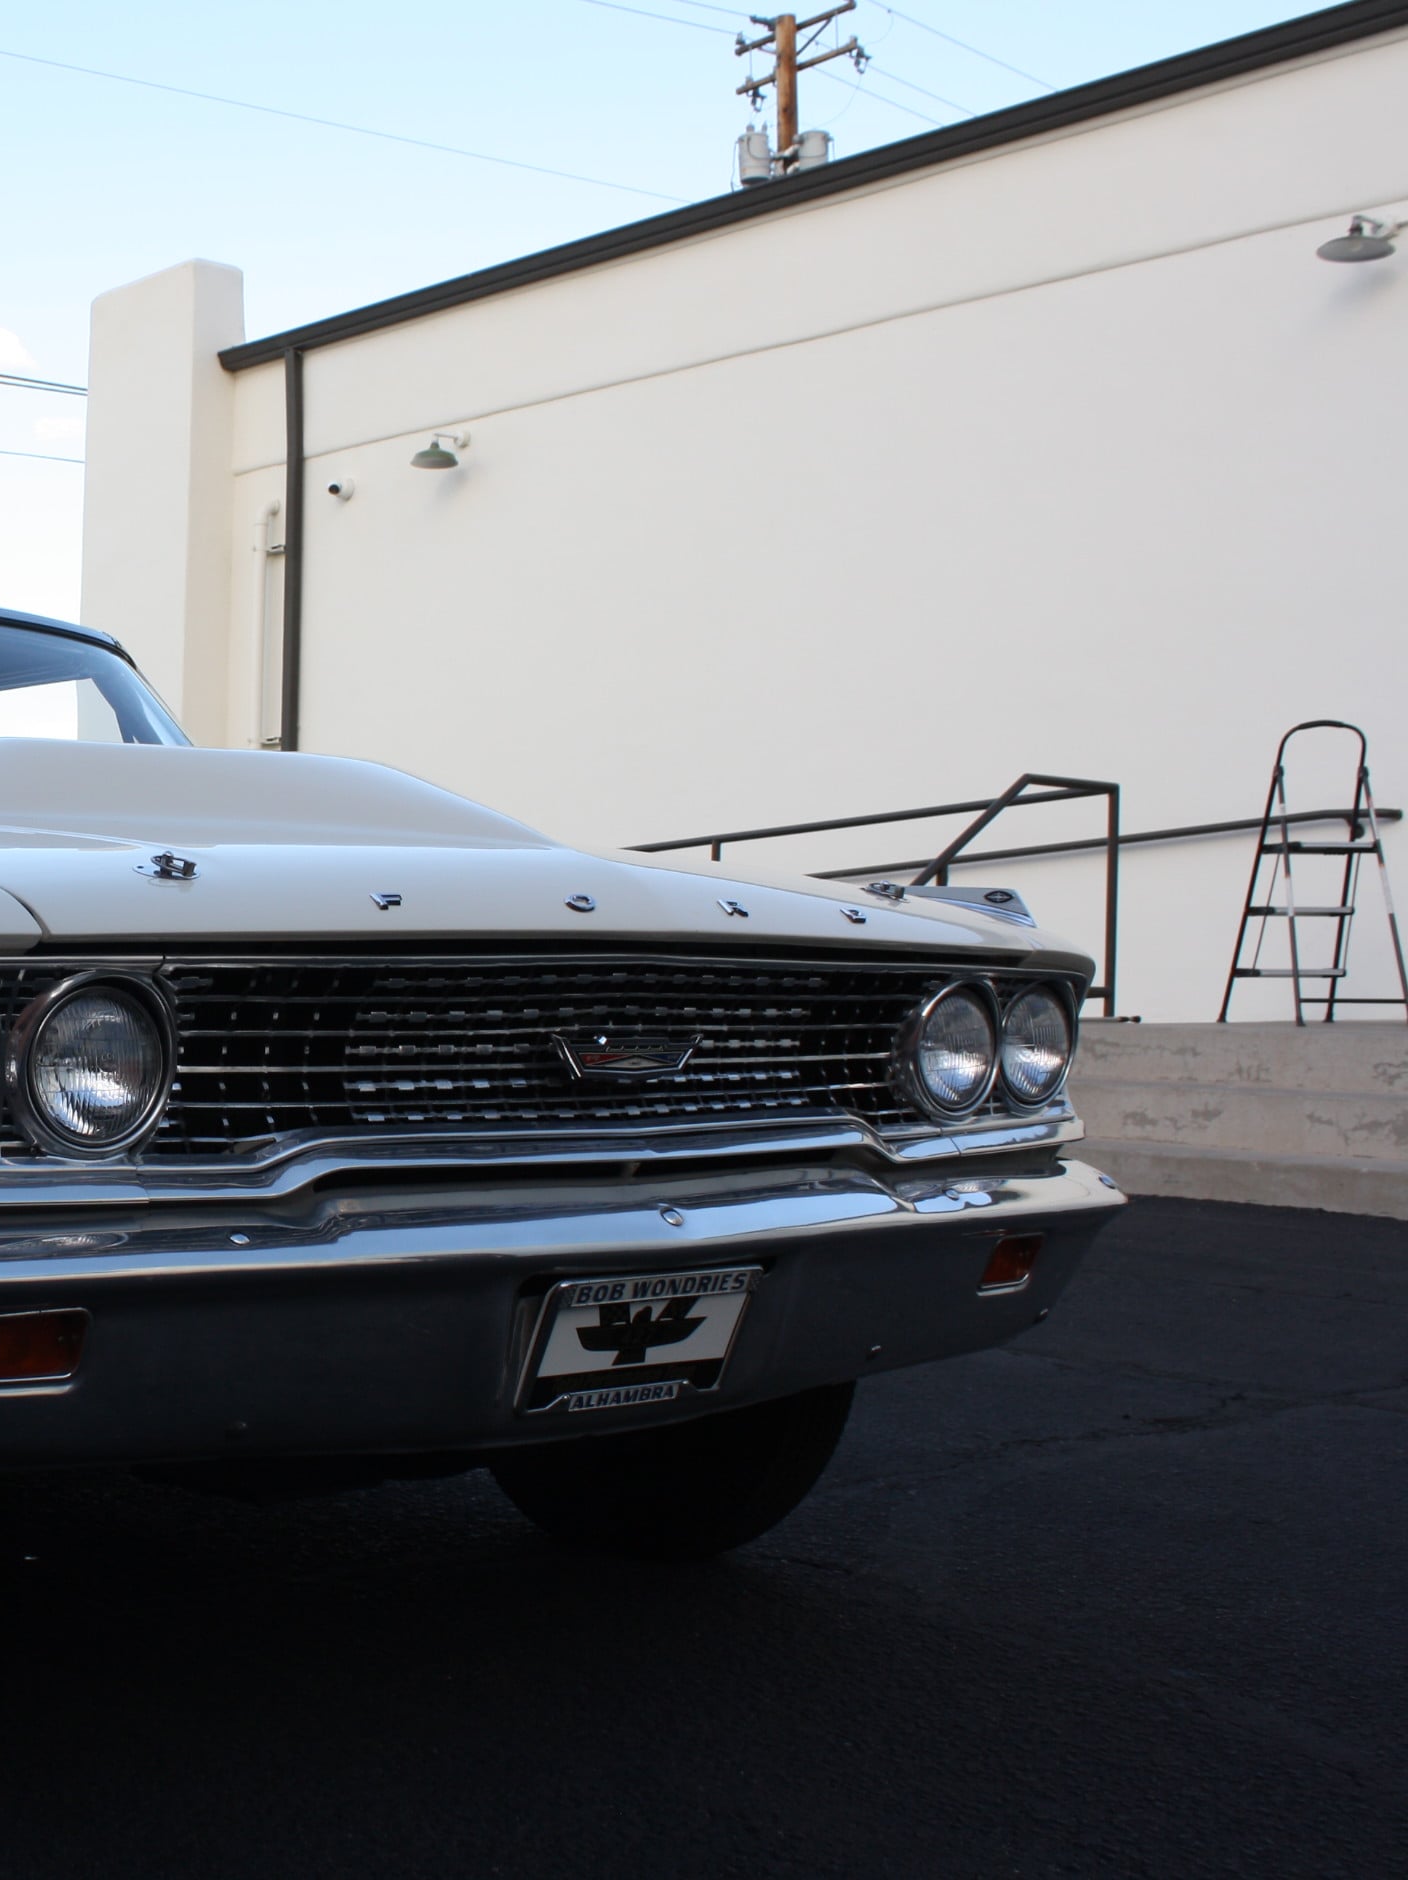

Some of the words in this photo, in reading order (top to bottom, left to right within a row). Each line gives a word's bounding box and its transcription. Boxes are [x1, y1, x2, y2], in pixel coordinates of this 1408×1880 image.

[369, 891, 867, 924] FORD
[576, 1282, 625, 1305] BOB
[631, 1272, 748, 1300] WONDRIES
[571, 1384, 677, 1411] ALHAMBRA
